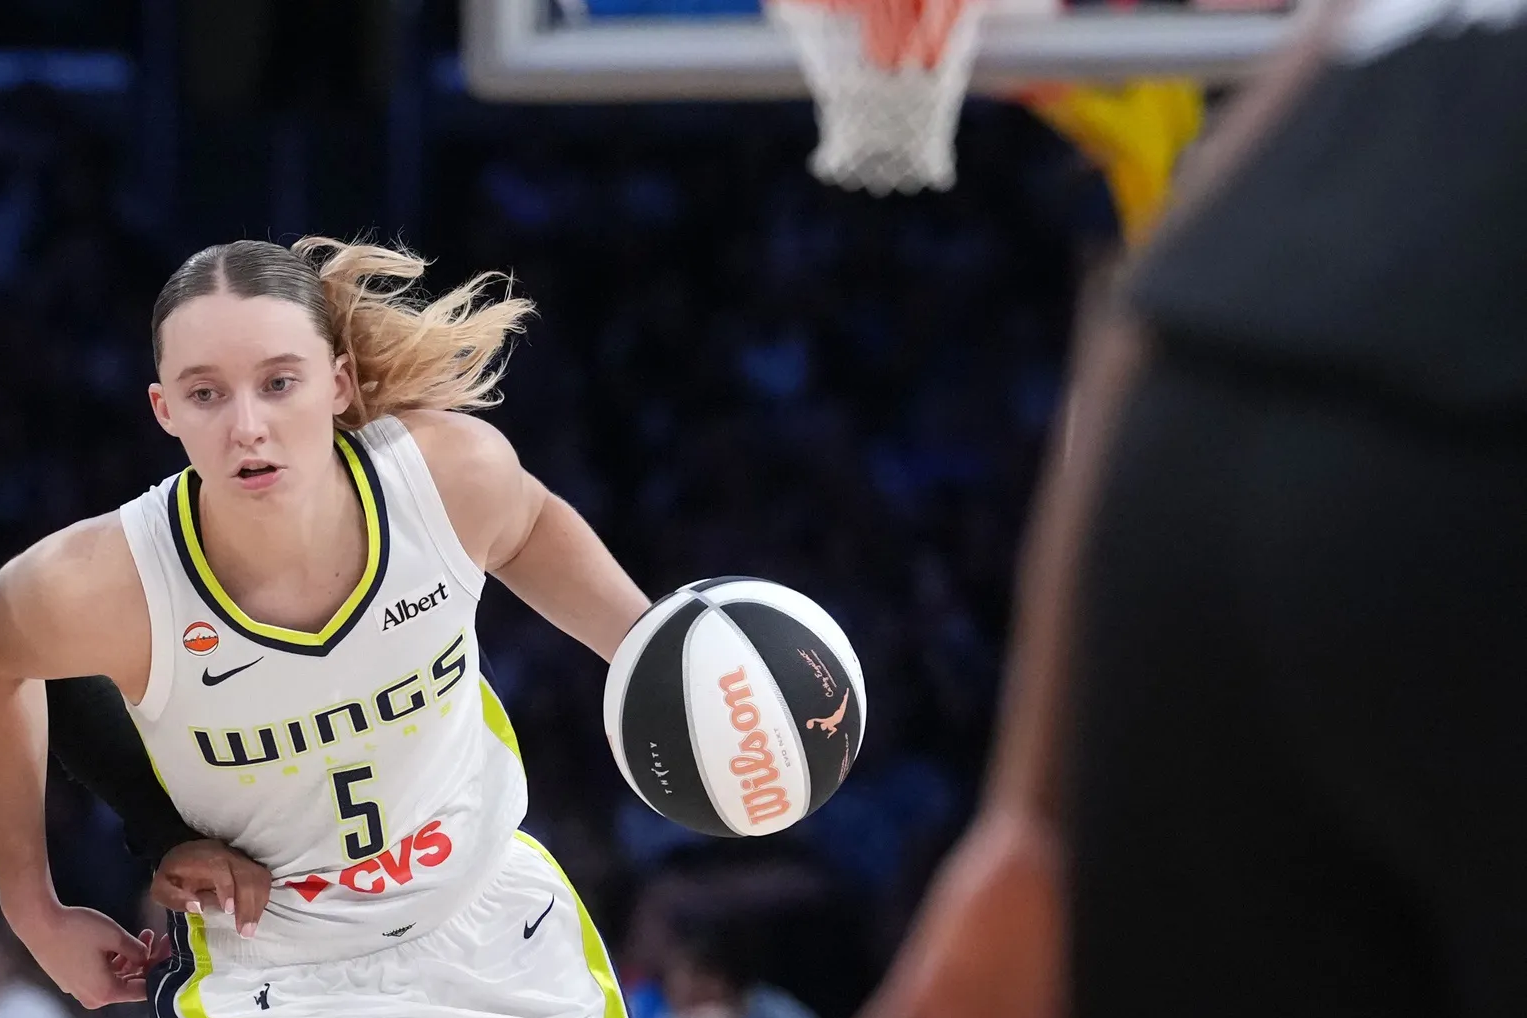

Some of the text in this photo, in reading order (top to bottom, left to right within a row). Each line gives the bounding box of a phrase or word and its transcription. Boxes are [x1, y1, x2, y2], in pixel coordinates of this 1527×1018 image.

[382, 582, 449, 632] Albert
[189, 628, 467, 768] WINGS
[718, 664, 792, 826] Wilson
[328, 762, 388, 863] 5
[338, 820, 453, 895] CVS
